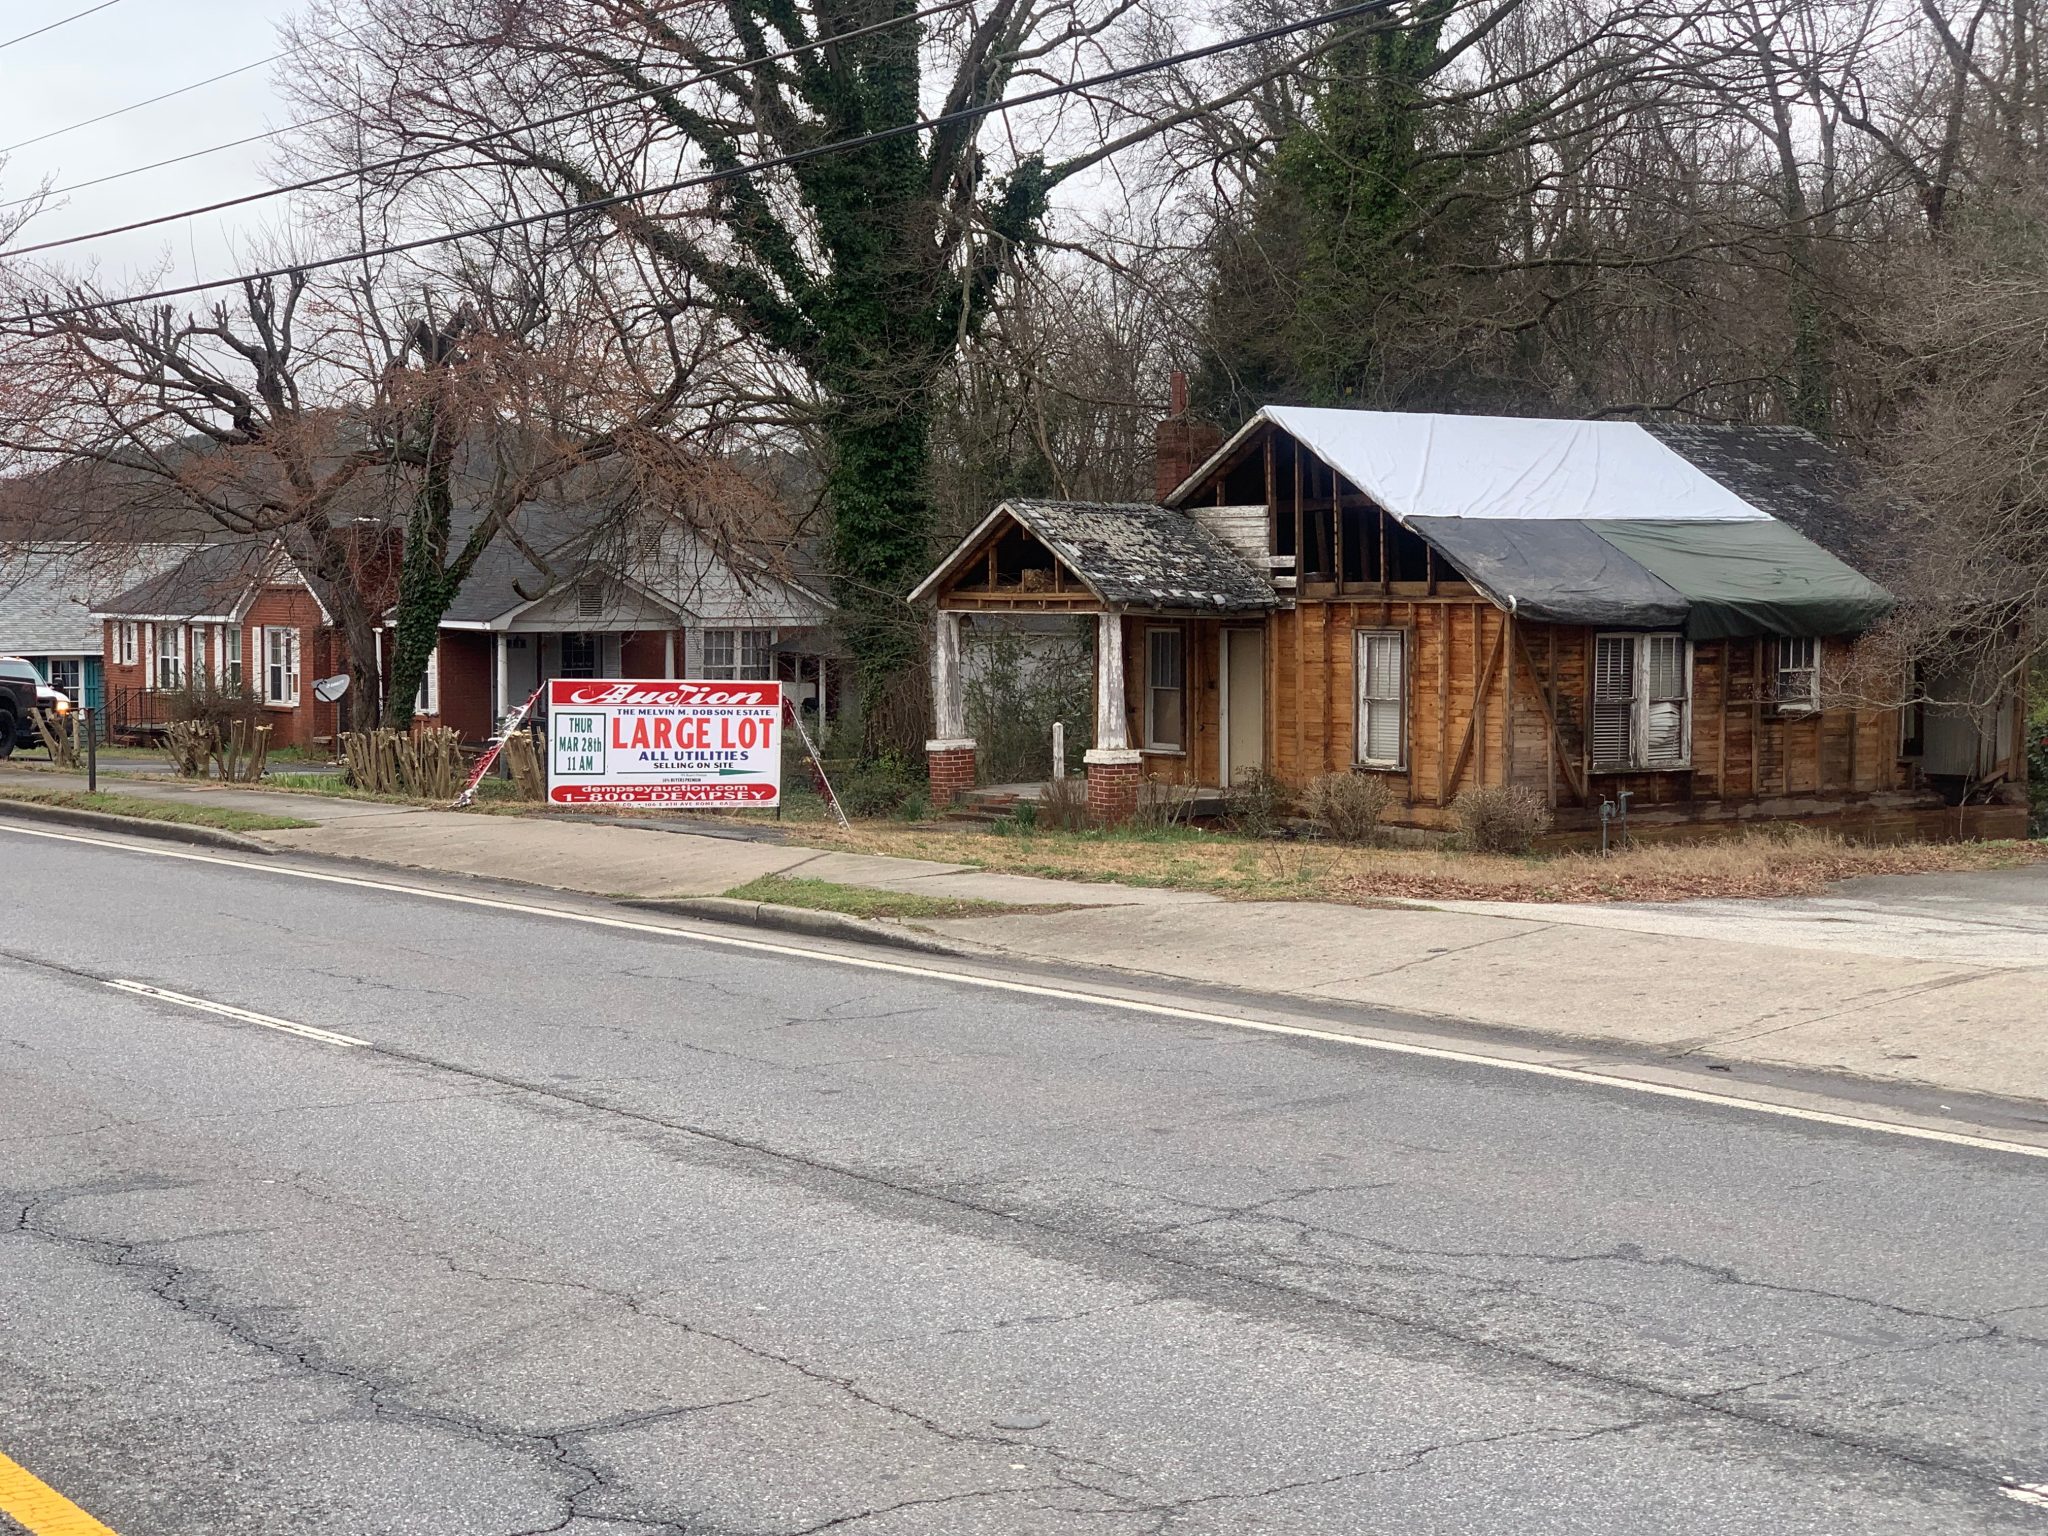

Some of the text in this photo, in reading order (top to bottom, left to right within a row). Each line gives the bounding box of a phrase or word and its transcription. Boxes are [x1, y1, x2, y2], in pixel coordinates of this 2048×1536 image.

[638, 708, 675, 716] MELVIN
[692, 708, 734, 716] DOBSON
[569, 717, 593, 733] THUR
[612, 717, 775, 749] LARGE LOT
[559, 736, 602, 752] MAR 28th
[639, 751, 749, 761] ALL UTILITIES
[567, 755, 593, 771] 11 AM
[581, 785, 748, 793] dempseyauction.com
[562, 791, 766, 802] 1-800-DEMPSEY
